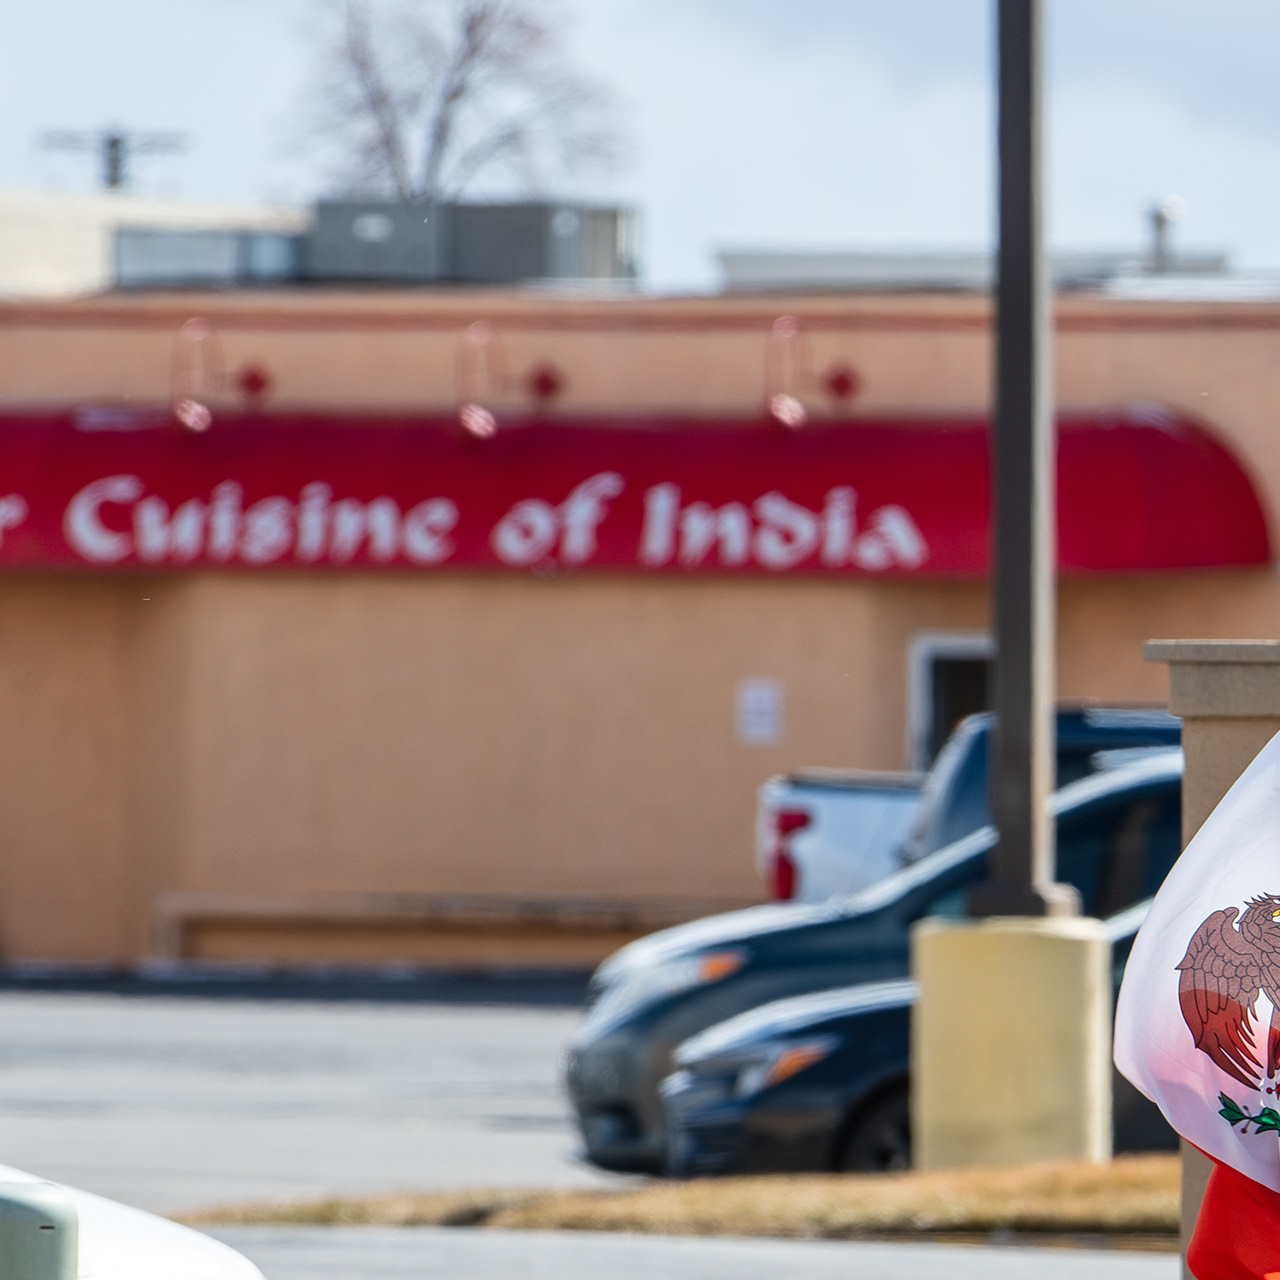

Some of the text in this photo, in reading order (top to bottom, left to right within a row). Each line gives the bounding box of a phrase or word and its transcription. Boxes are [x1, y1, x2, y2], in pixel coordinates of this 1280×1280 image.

[62, 473, 460, 566] Cuisine
[490, 470, 625, 567] of
[638, 481, 929, 571] India
